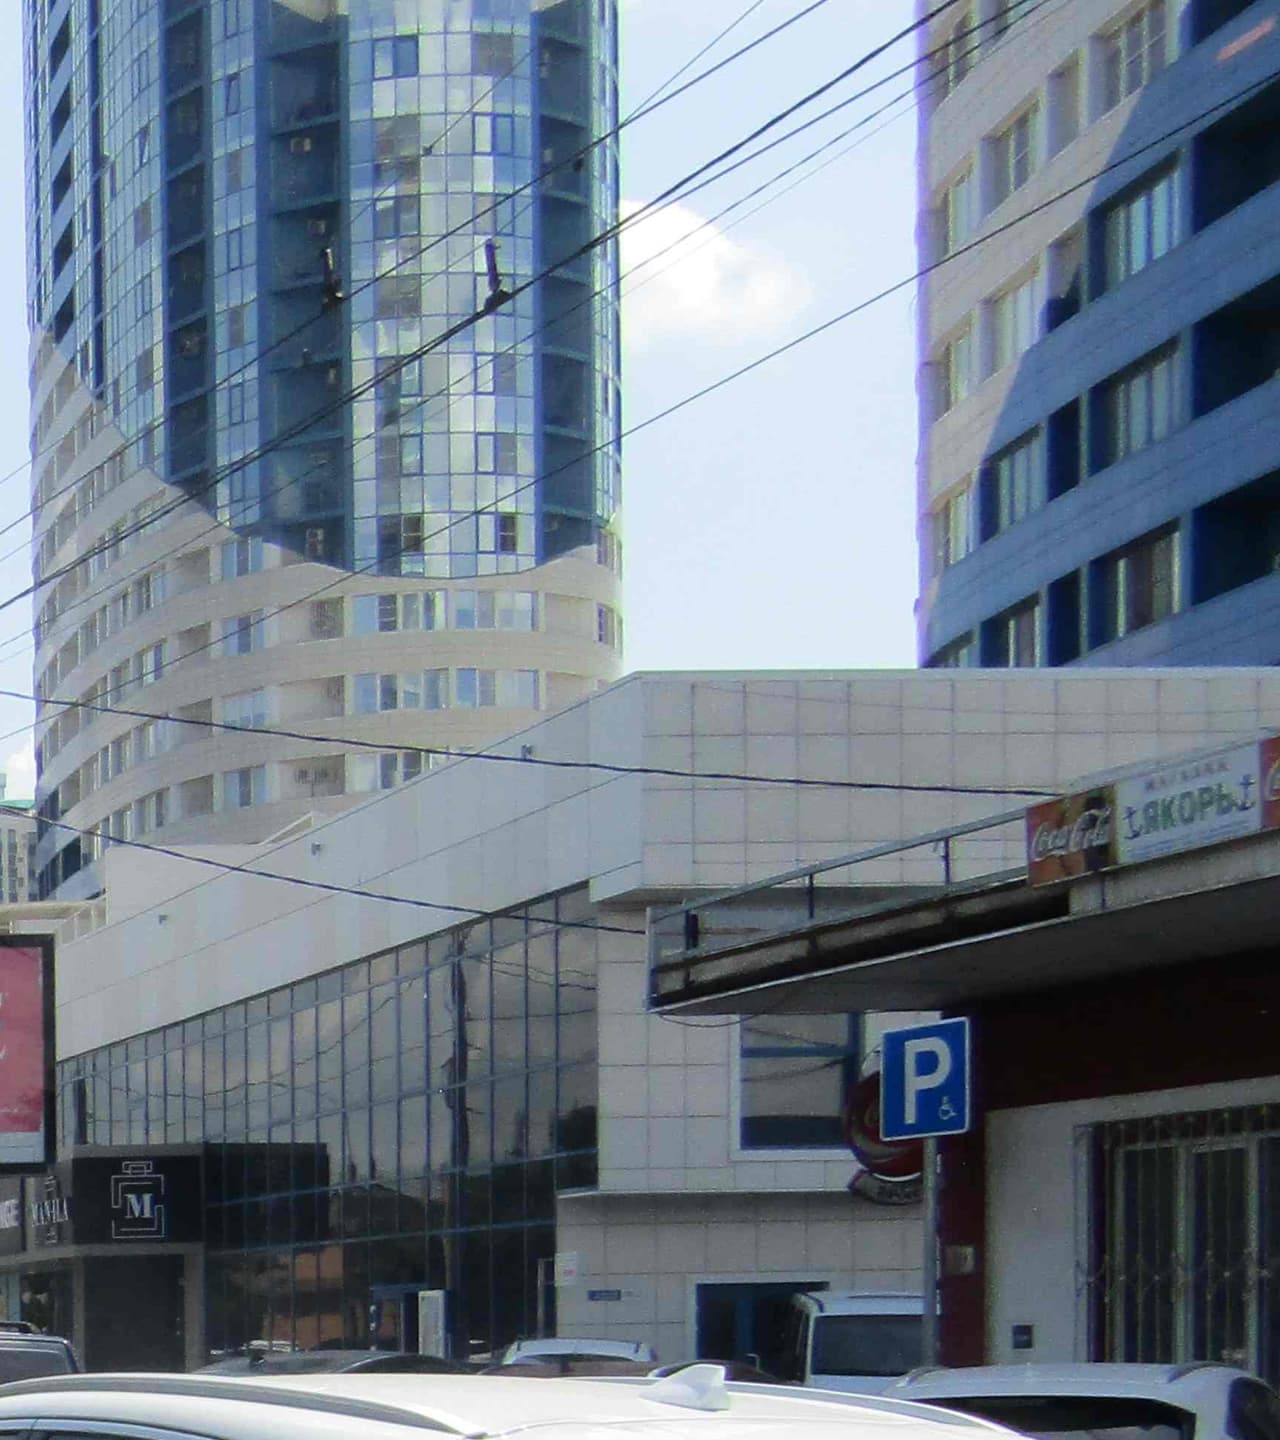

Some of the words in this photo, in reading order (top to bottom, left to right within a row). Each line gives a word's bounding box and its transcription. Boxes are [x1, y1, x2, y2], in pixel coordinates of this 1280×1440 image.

[1143, 784, 1233, 834] ЯКОРЬ
[904, 1037, 952, 1125] P
[124, 1193, 155, 1218] M
